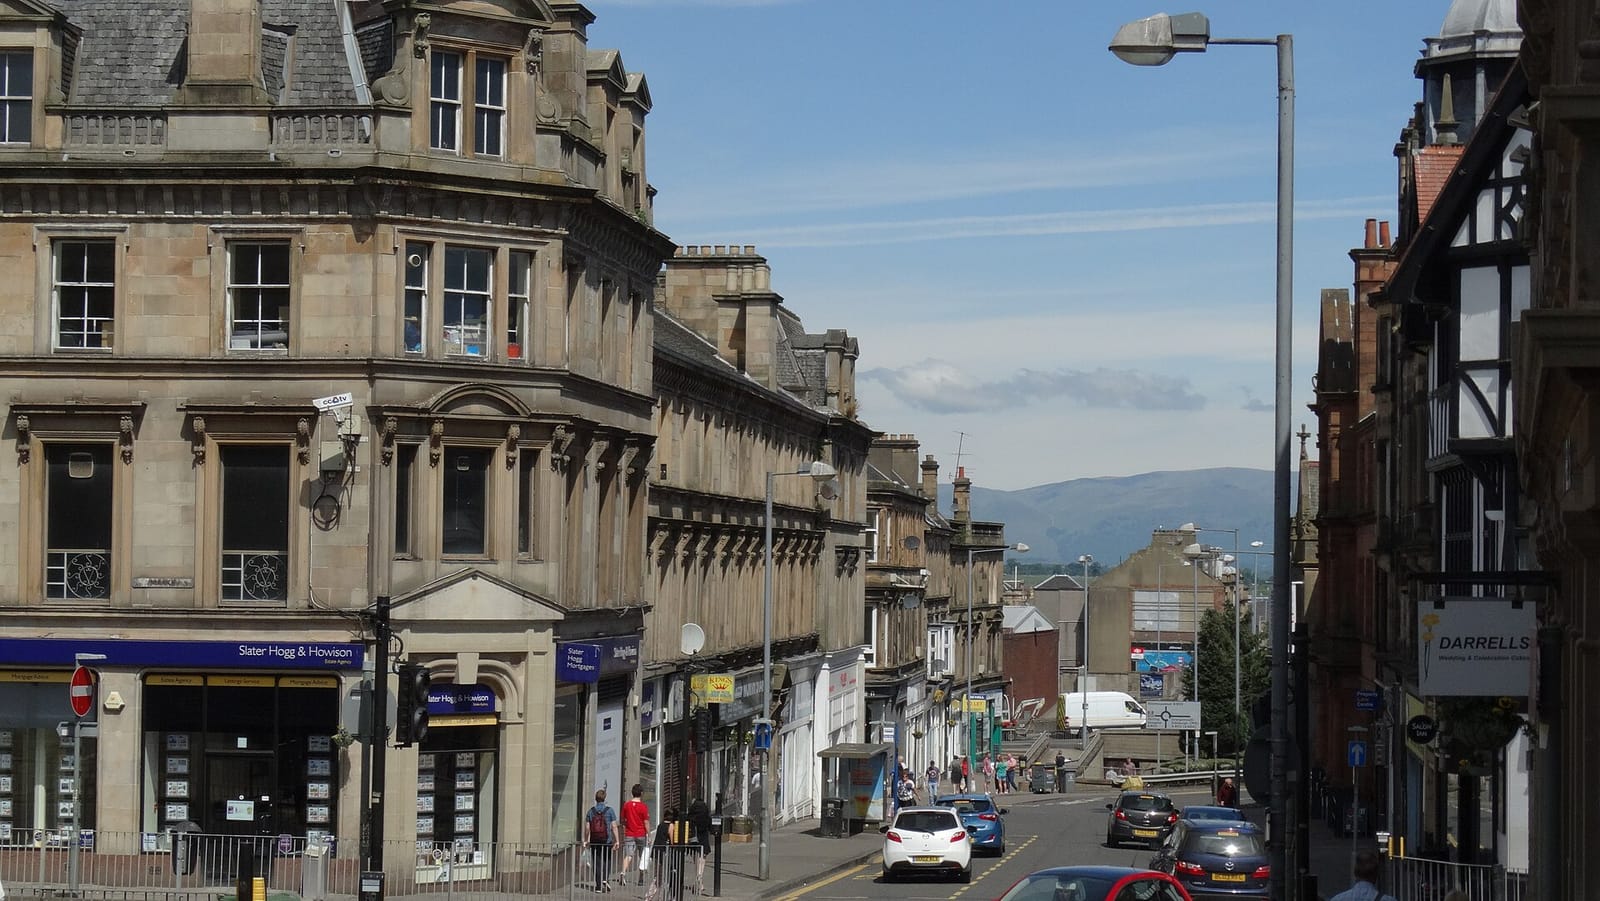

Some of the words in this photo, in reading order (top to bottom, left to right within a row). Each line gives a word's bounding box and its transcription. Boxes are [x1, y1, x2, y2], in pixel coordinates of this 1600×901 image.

[1439, 636, 1530, 650] DARRELLS
[239, 645, 267, 656] Slater
[269, 645, 296, 659] Hogg
[297, 646, 307, 657] &
[309, 646, 353, 657] Howison
[567, 647, 585, 655] Slater
[567, 655, 583, 664] Hogg
[566, 662, 595, 671] Mortgages
